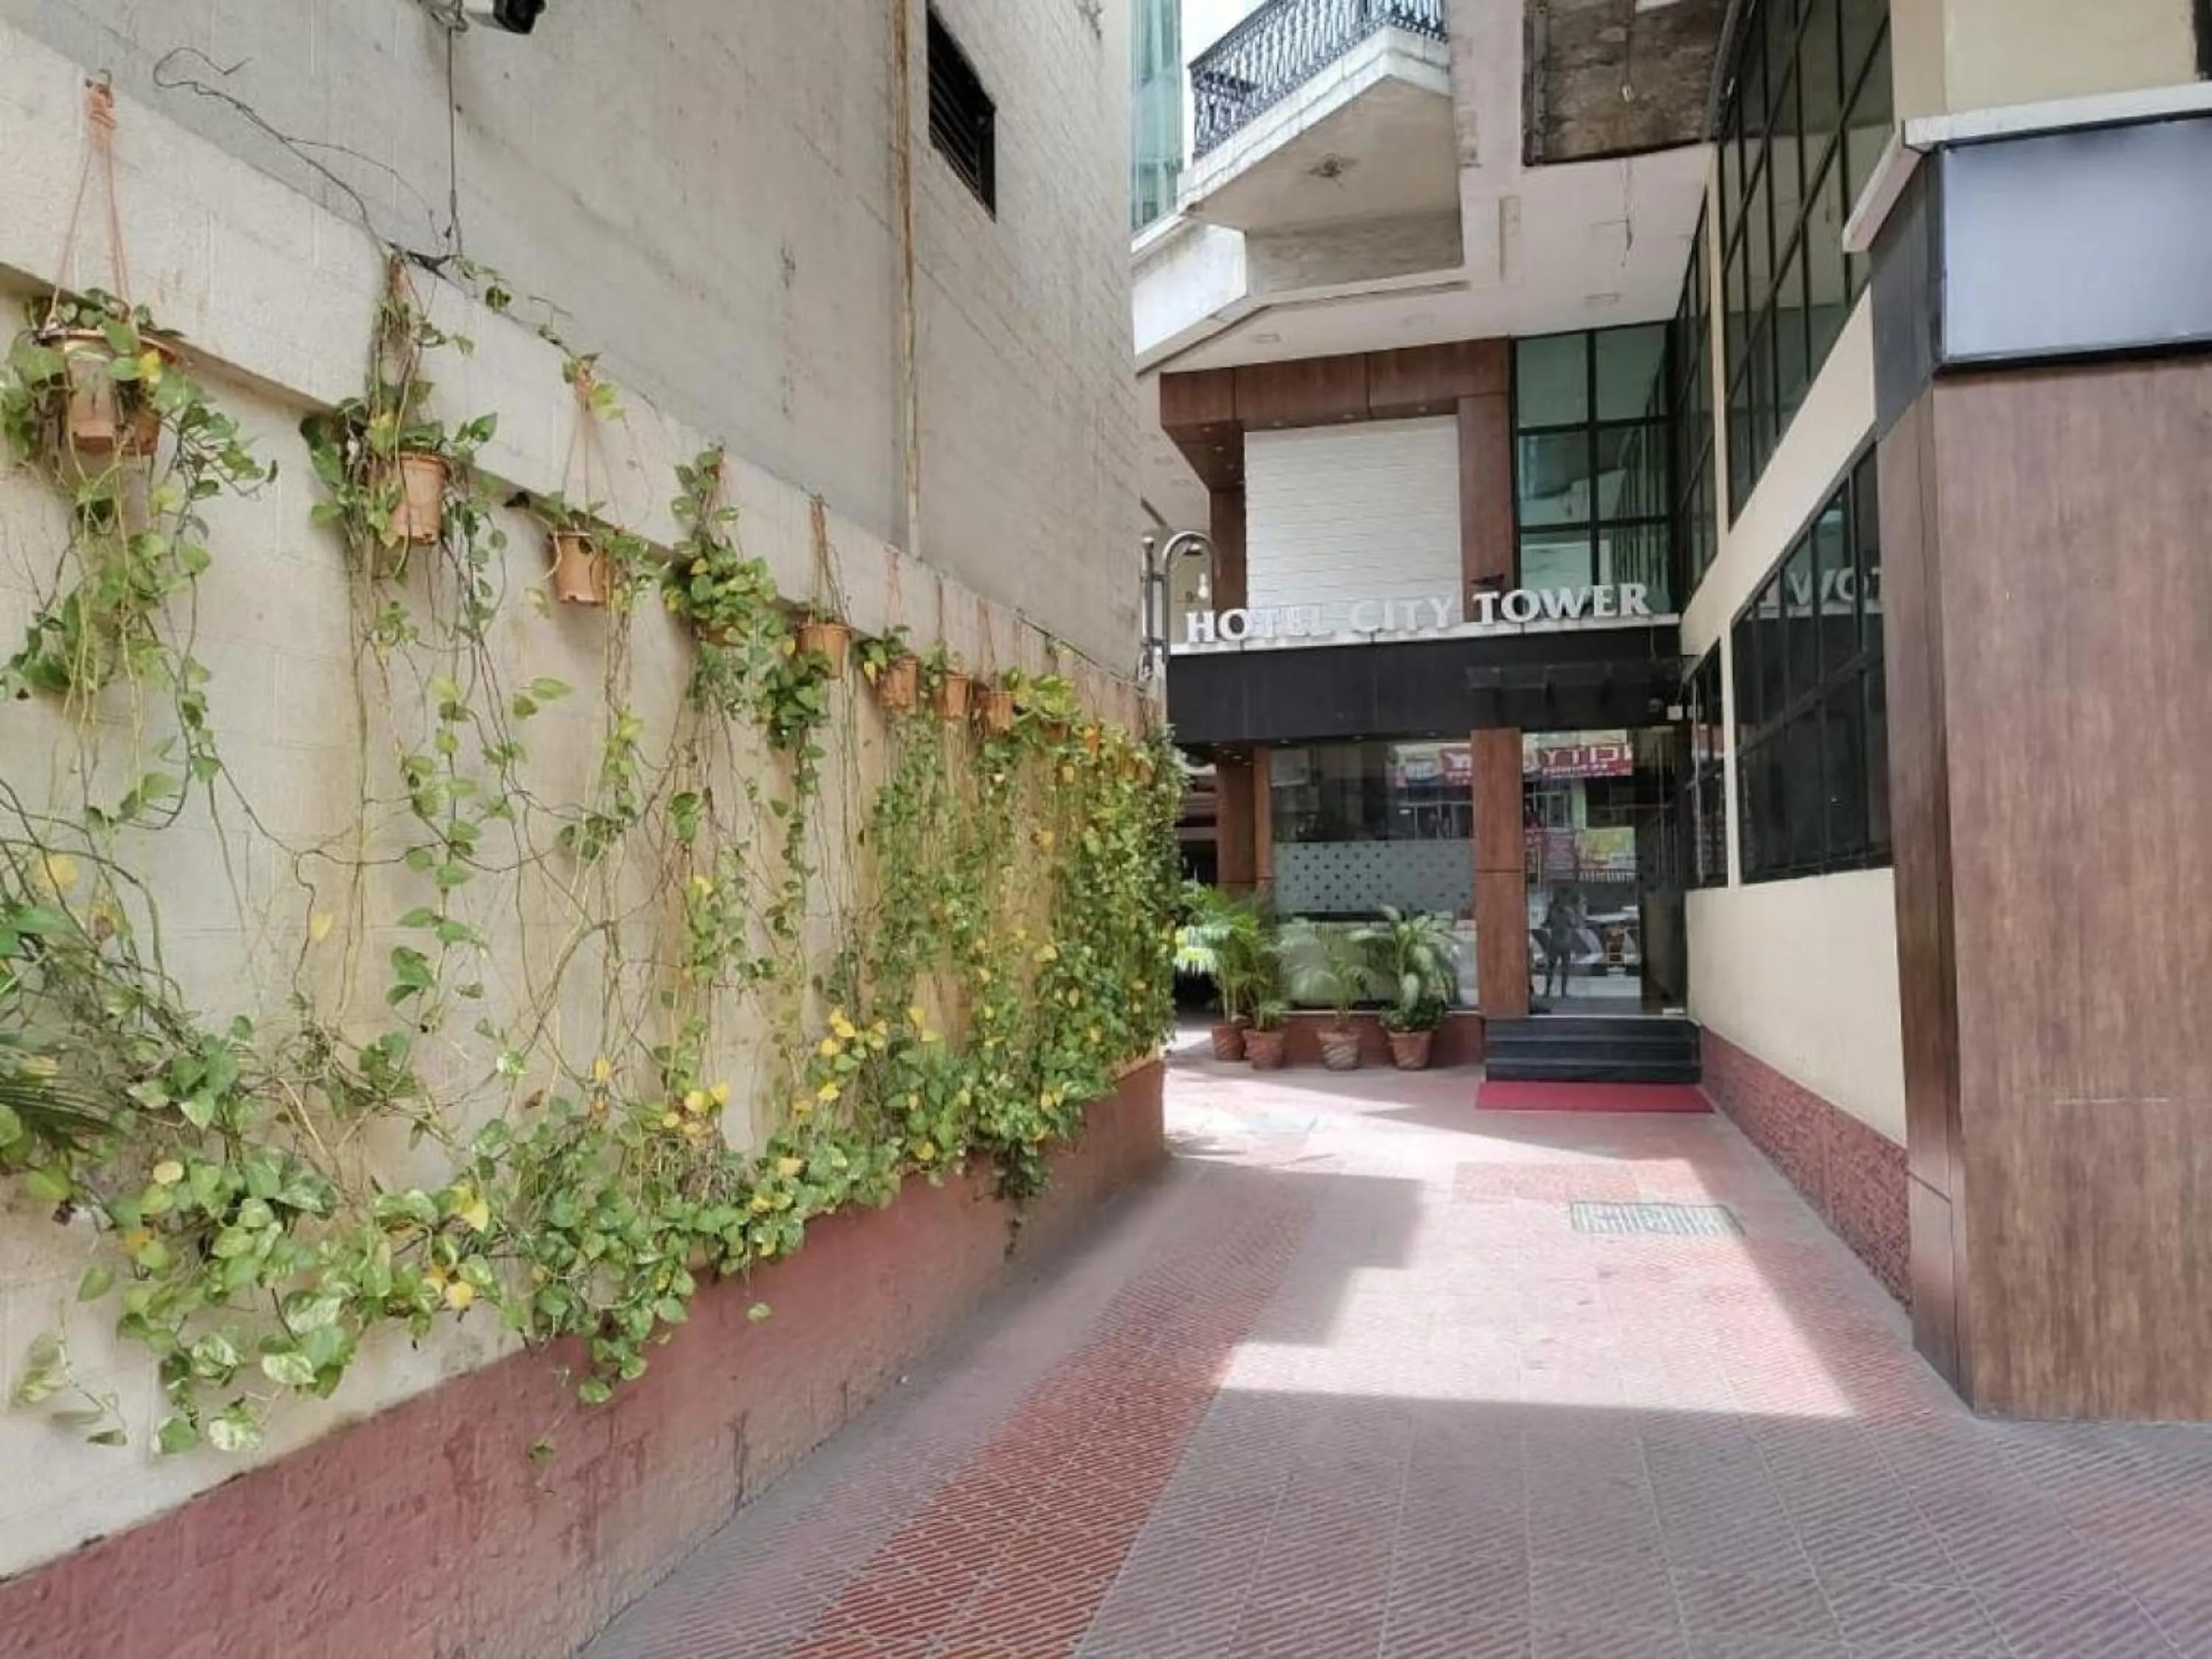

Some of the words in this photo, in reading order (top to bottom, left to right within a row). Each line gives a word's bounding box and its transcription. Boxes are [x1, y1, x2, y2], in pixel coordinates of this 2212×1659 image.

[1186, 605, 1332, 643] HOTEL
[1349, 597, 1453, 632] CITY
[1473, 583, 1651, 625] TOWER
